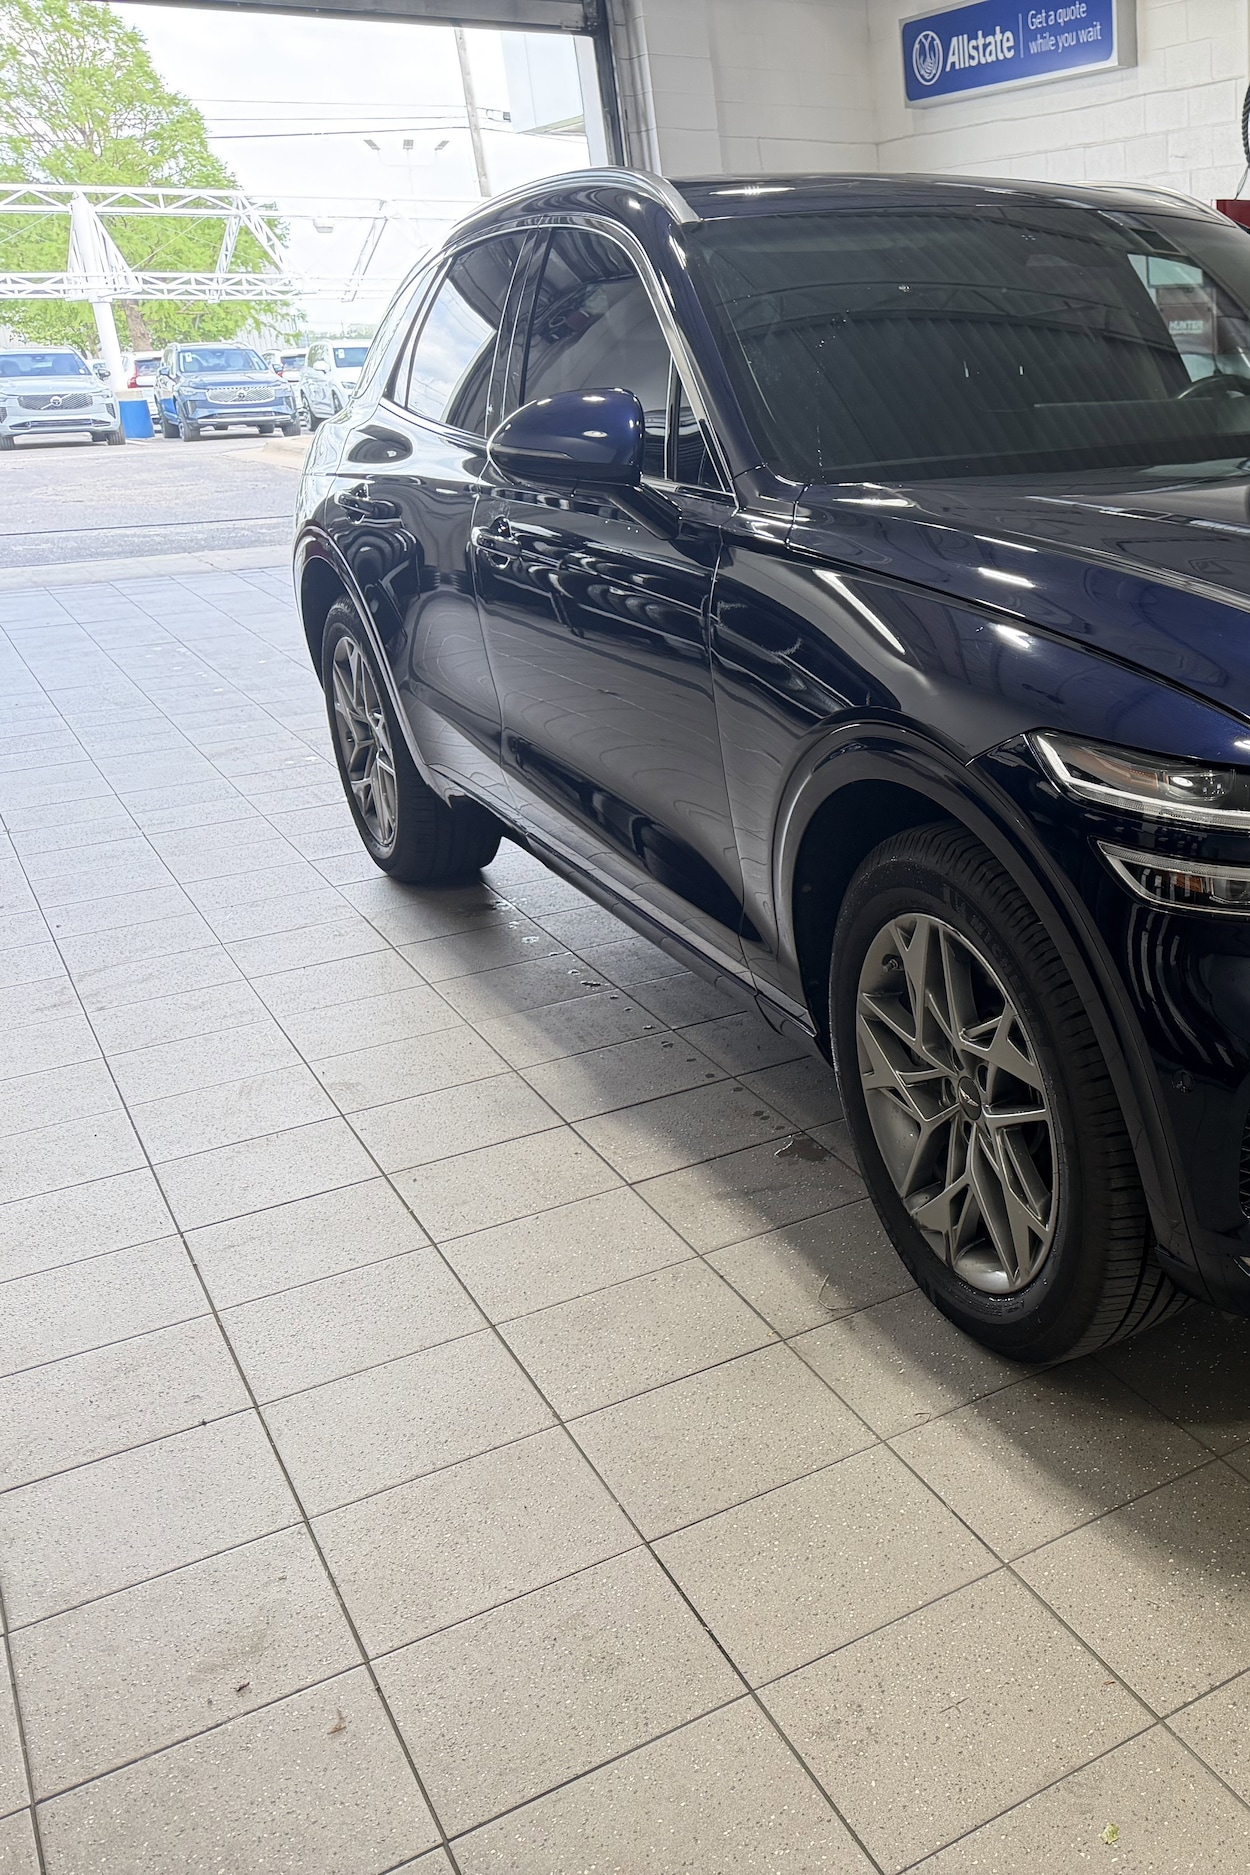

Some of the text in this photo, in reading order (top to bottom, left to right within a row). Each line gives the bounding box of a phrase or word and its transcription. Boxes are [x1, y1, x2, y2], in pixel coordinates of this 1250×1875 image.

[1028, 1, 1087, 30] Get a quote
[945, 25, 1015, 72] Allstate
[1029, 21, 1102, 54] while you wait
